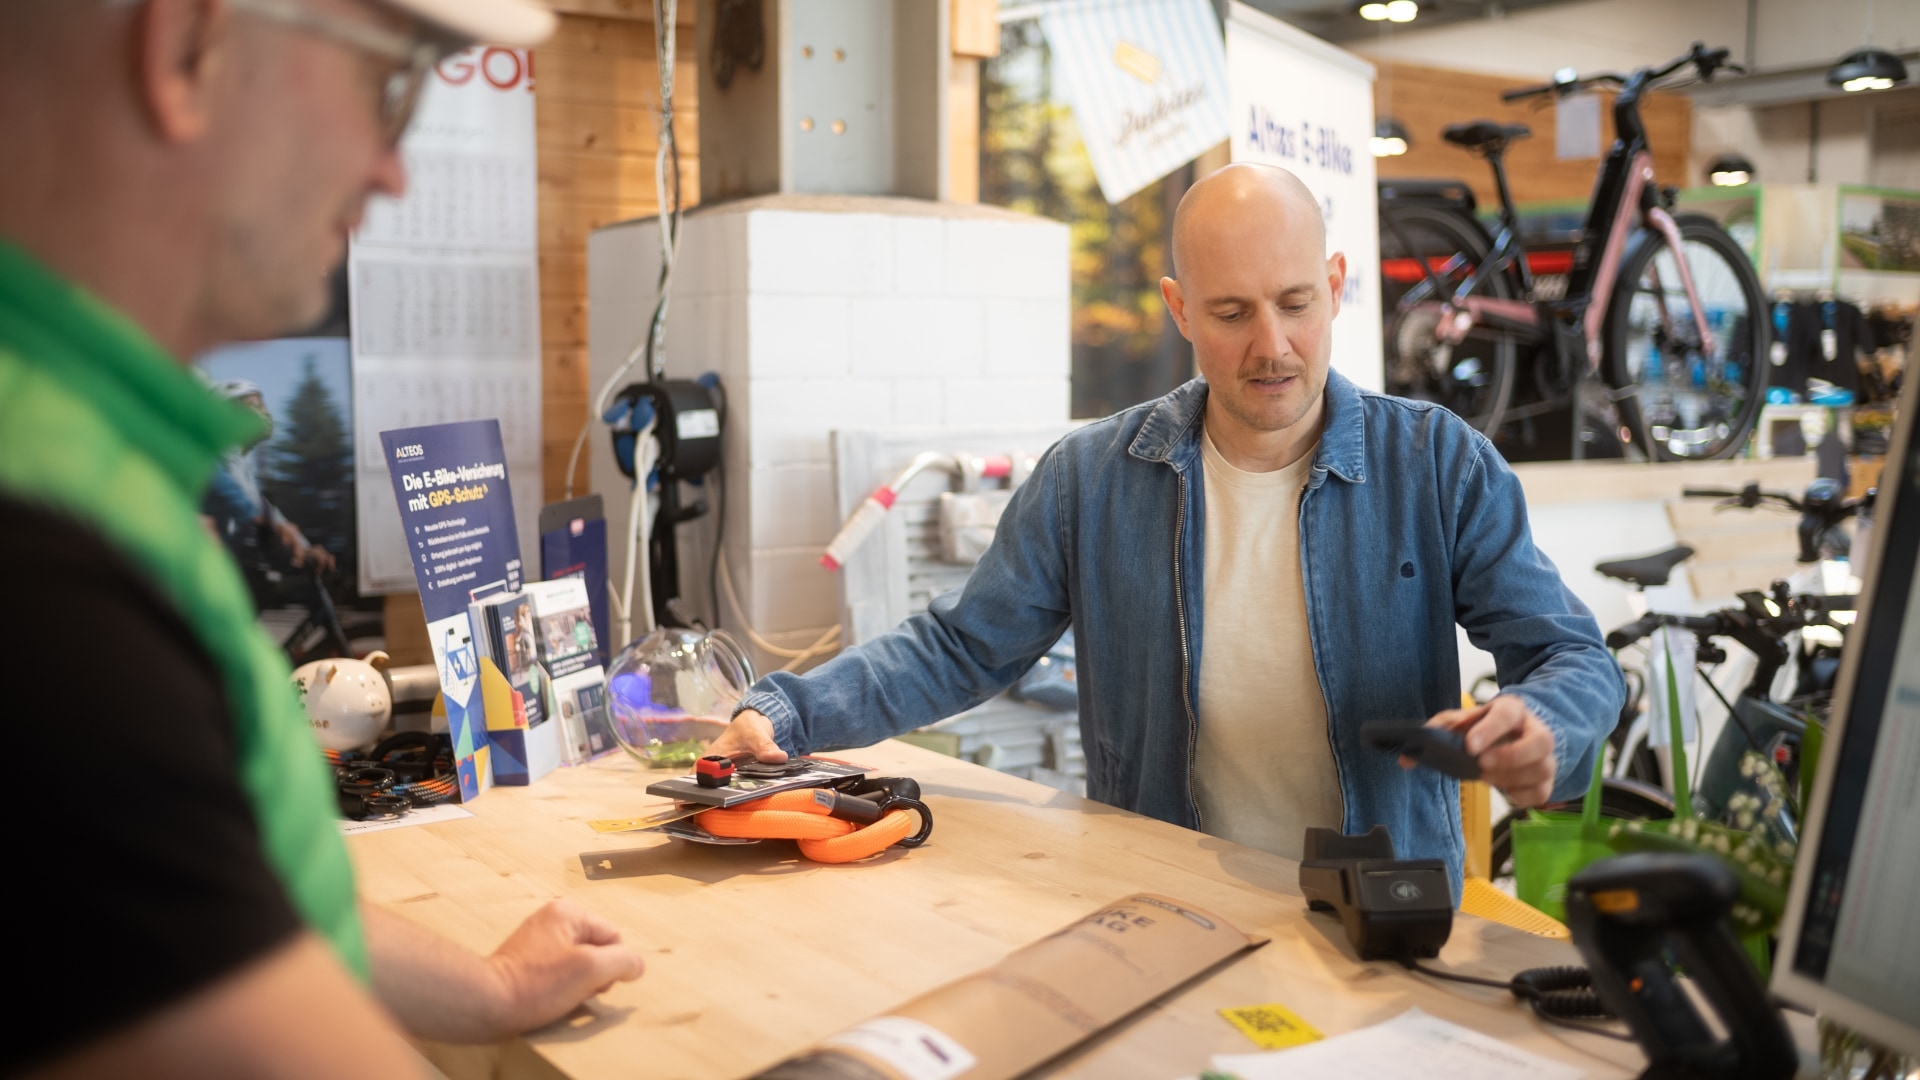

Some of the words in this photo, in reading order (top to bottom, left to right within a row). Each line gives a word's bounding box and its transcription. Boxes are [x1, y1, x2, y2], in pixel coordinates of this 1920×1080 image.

[396, 444, 424, 458] ALTEOS
[402, 473, 424, 491] Die
[423, 462, 505, 487] E-Bike-Versicherung
[408, 493, 430, 512] mit
